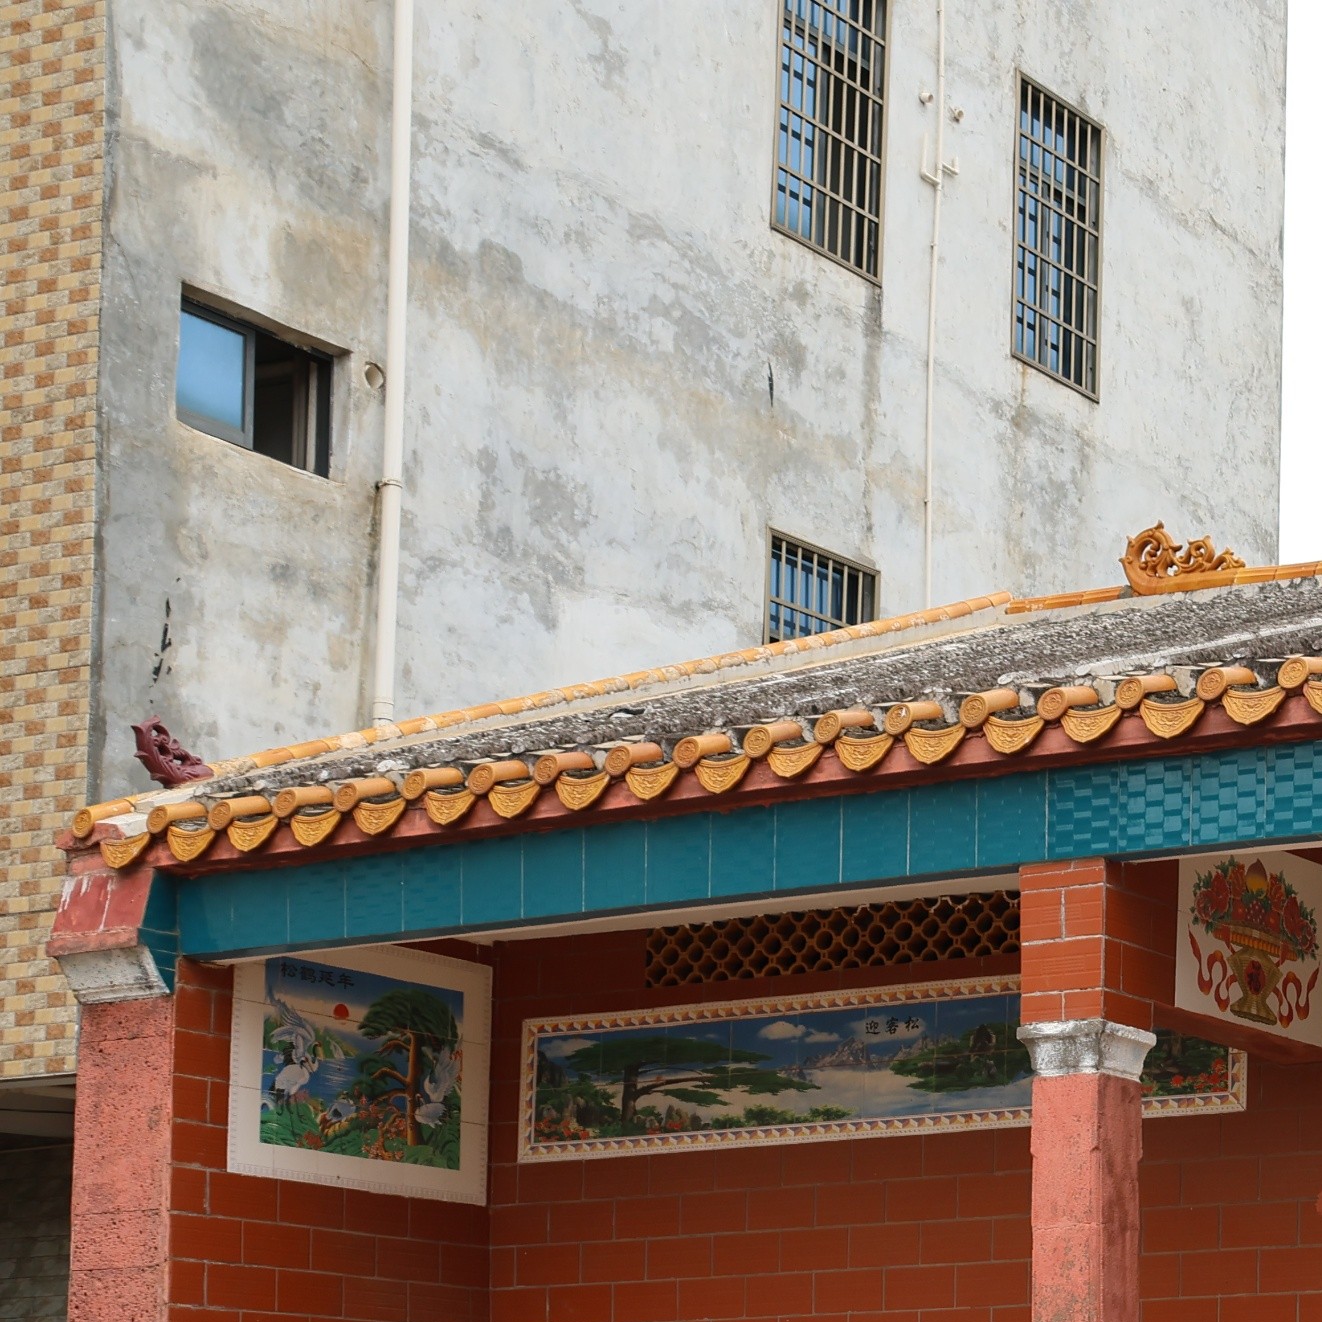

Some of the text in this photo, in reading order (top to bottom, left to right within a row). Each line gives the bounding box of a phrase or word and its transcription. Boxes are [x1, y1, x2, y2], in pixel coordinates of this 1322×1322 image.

[280, 962, 354, 989] 松鹤延年
[865, 1016, 920, 1035] 迎客松
